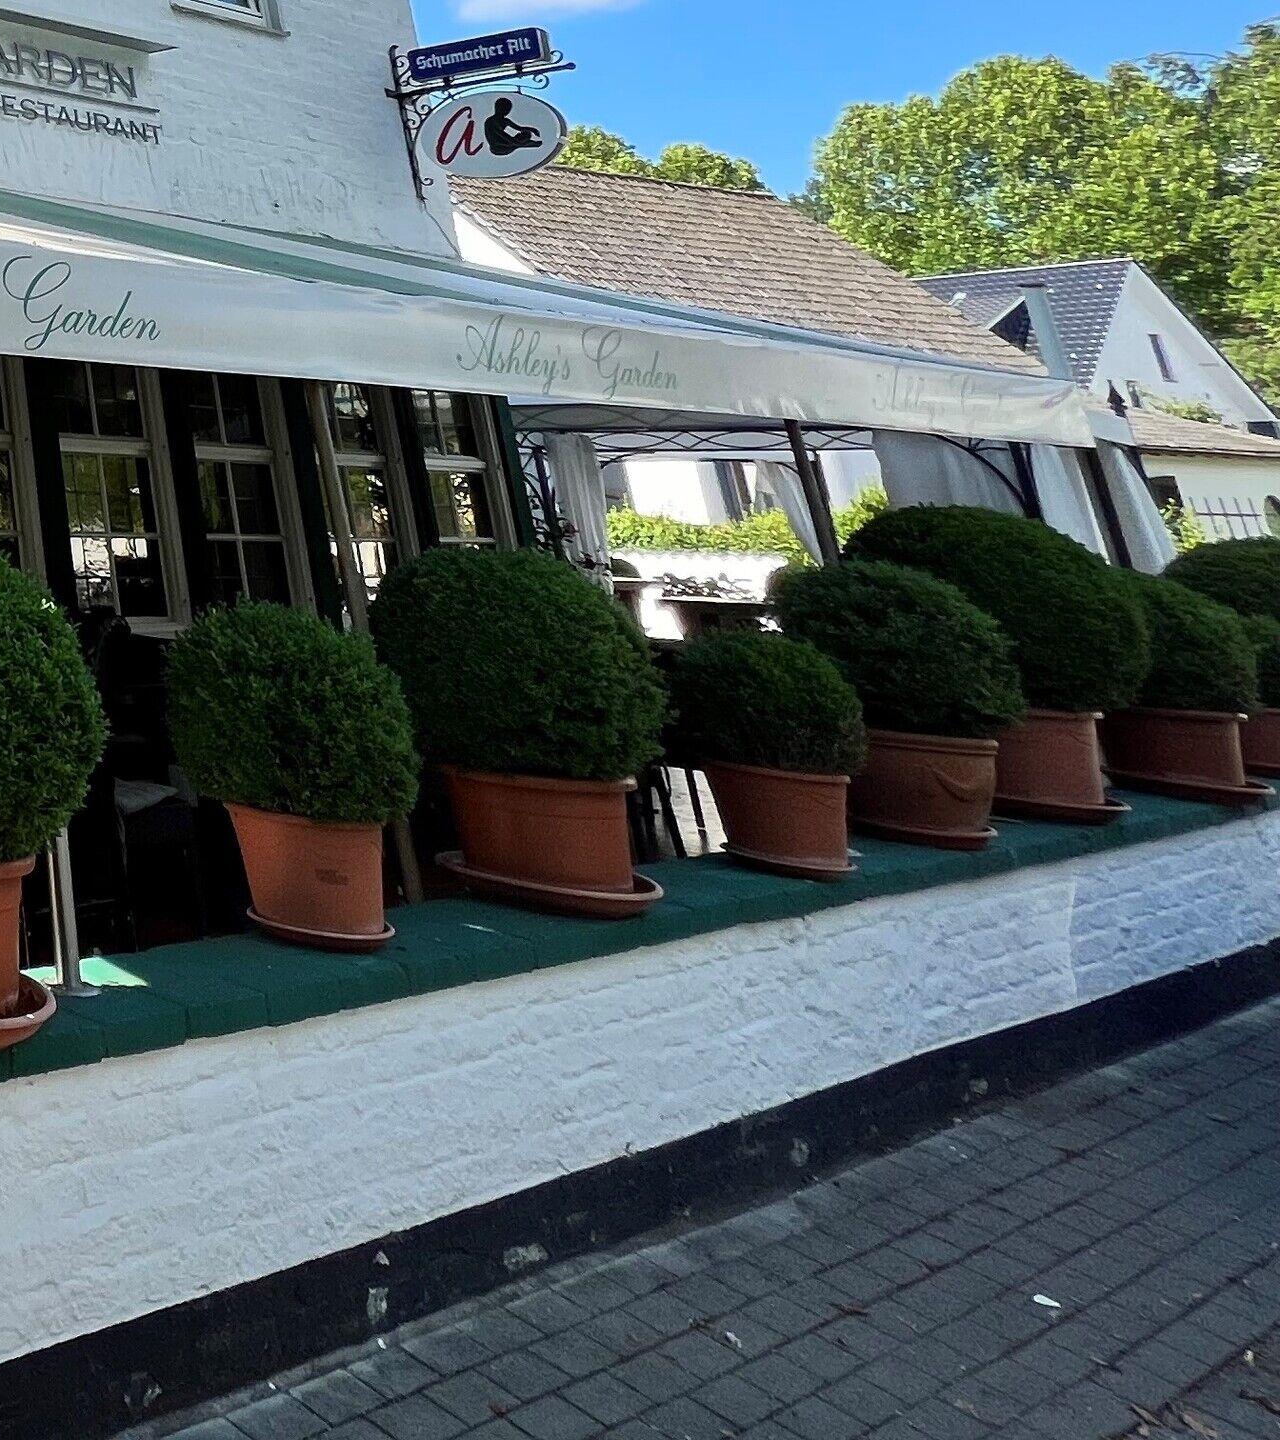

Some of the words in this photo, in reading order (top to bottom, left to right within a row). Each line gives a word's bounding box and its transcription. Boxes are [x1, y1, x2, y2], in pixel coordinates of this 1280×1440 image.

[415, 42, 505, 71] Schumacher
[506, 36, 531, 56] Alt
[2, 255, 161, 351] Garden
[455, 313, 571, 395] Ashley's
[581, 326, 678, 400] Garden
